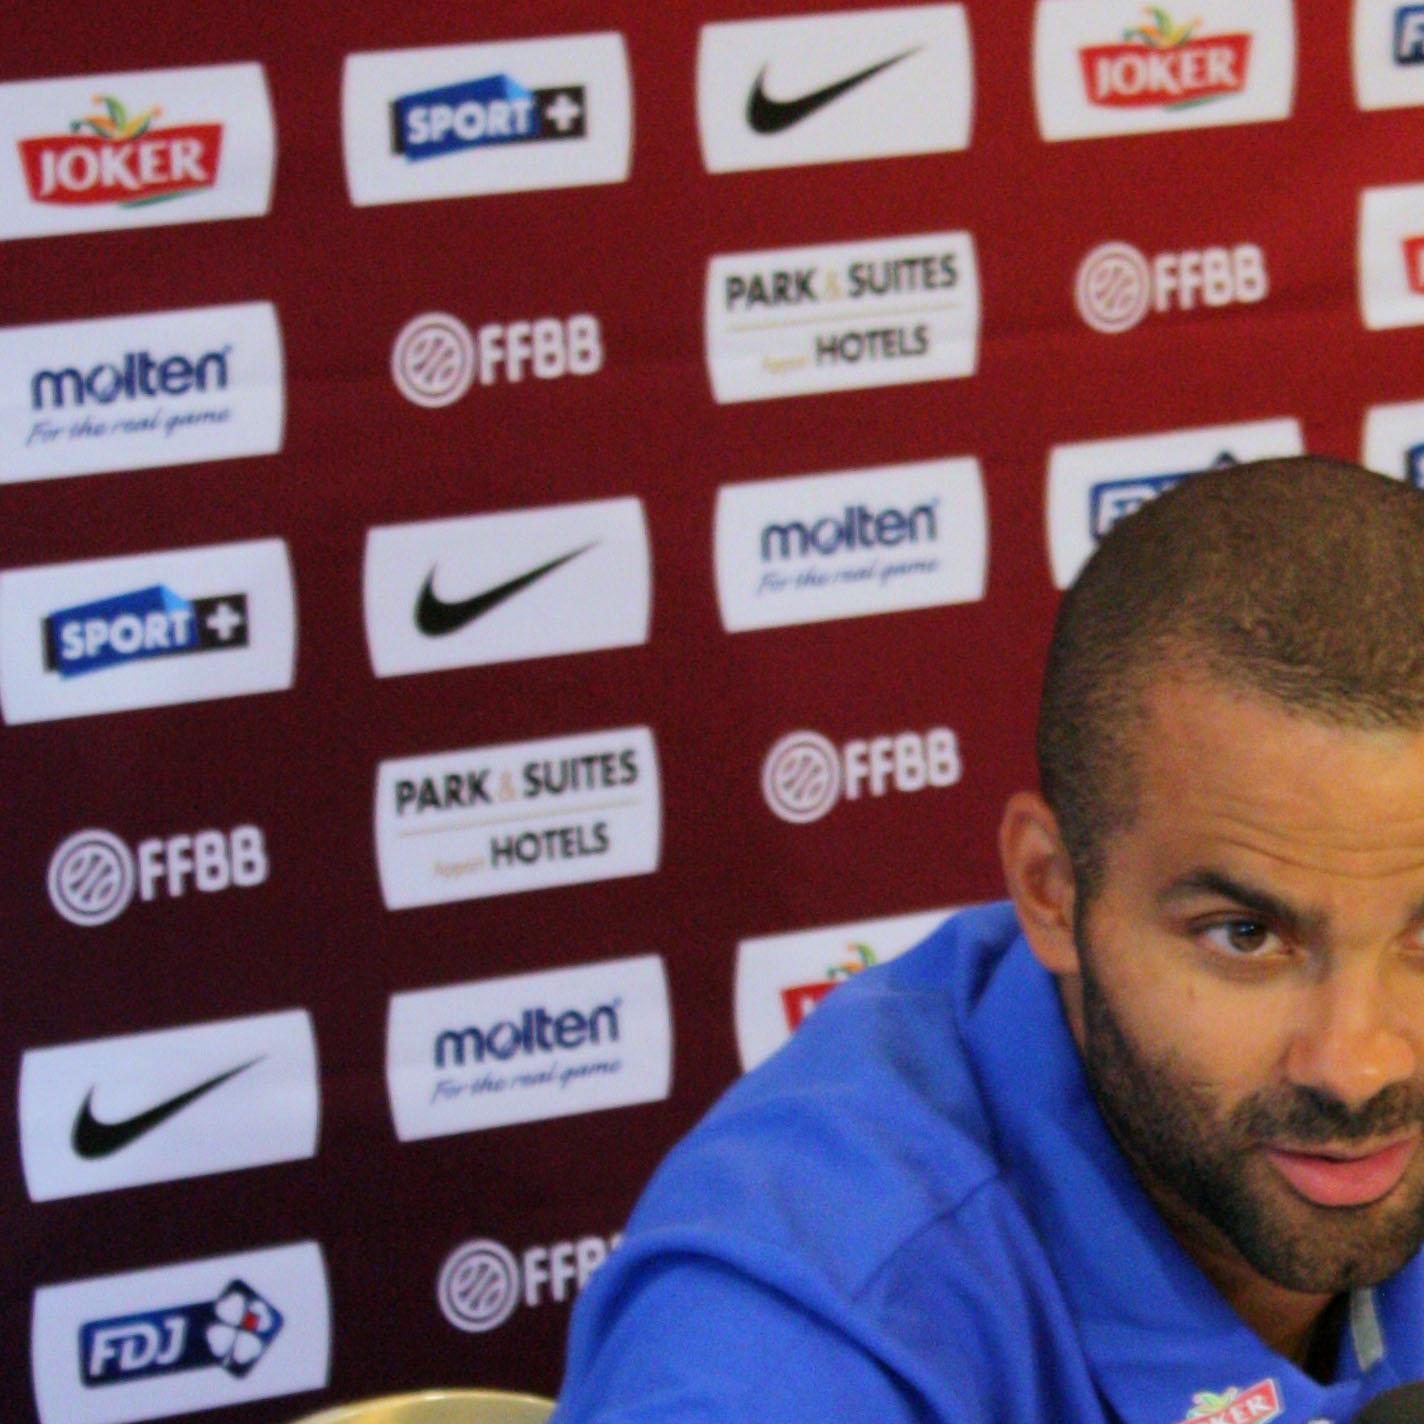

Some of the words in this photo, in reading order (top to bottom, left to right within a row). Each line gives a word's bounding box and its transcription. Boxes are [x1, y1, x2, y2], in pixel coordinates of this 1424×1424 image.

[1095, 44, 1241, 96] JOKER
[39, 138, 210, 195] JOKER
[725, 267, 817, 310] PARK
[847, 253, 958, 298] SUITES
[1155, 243, 1269, 313] FFBB
[478, 315, 604, 385] FFBB
[815, 325, 929, 367] HOTELS
[31, 350, 228, 412] molten
[26, 421, 64, 449] For
[69, 417, 106, 439] the
[111, 411, 160, 435] real
[165, 408, 230, 438] game
[761, 504, 937, 563] molten
[394, 770, 490, 816] PARK
[523, 749, 638, 797] SUITES
[844, 726, 961, 800] FFBB
[137, 824, 268, 902] FFBB
[490, 822, 609, 868] HOTELS
[434, 1003, 620, 1069] molten
[430, 1078, 467, 1104] For
[471, 1073, 506, 1094] the
[511, 1069, 555, 1089] real
[559, 1060, 622, 1089] game
[523, 1233, 622, 1308] FFB
[88, 1312, 190, 1377] FDJ
